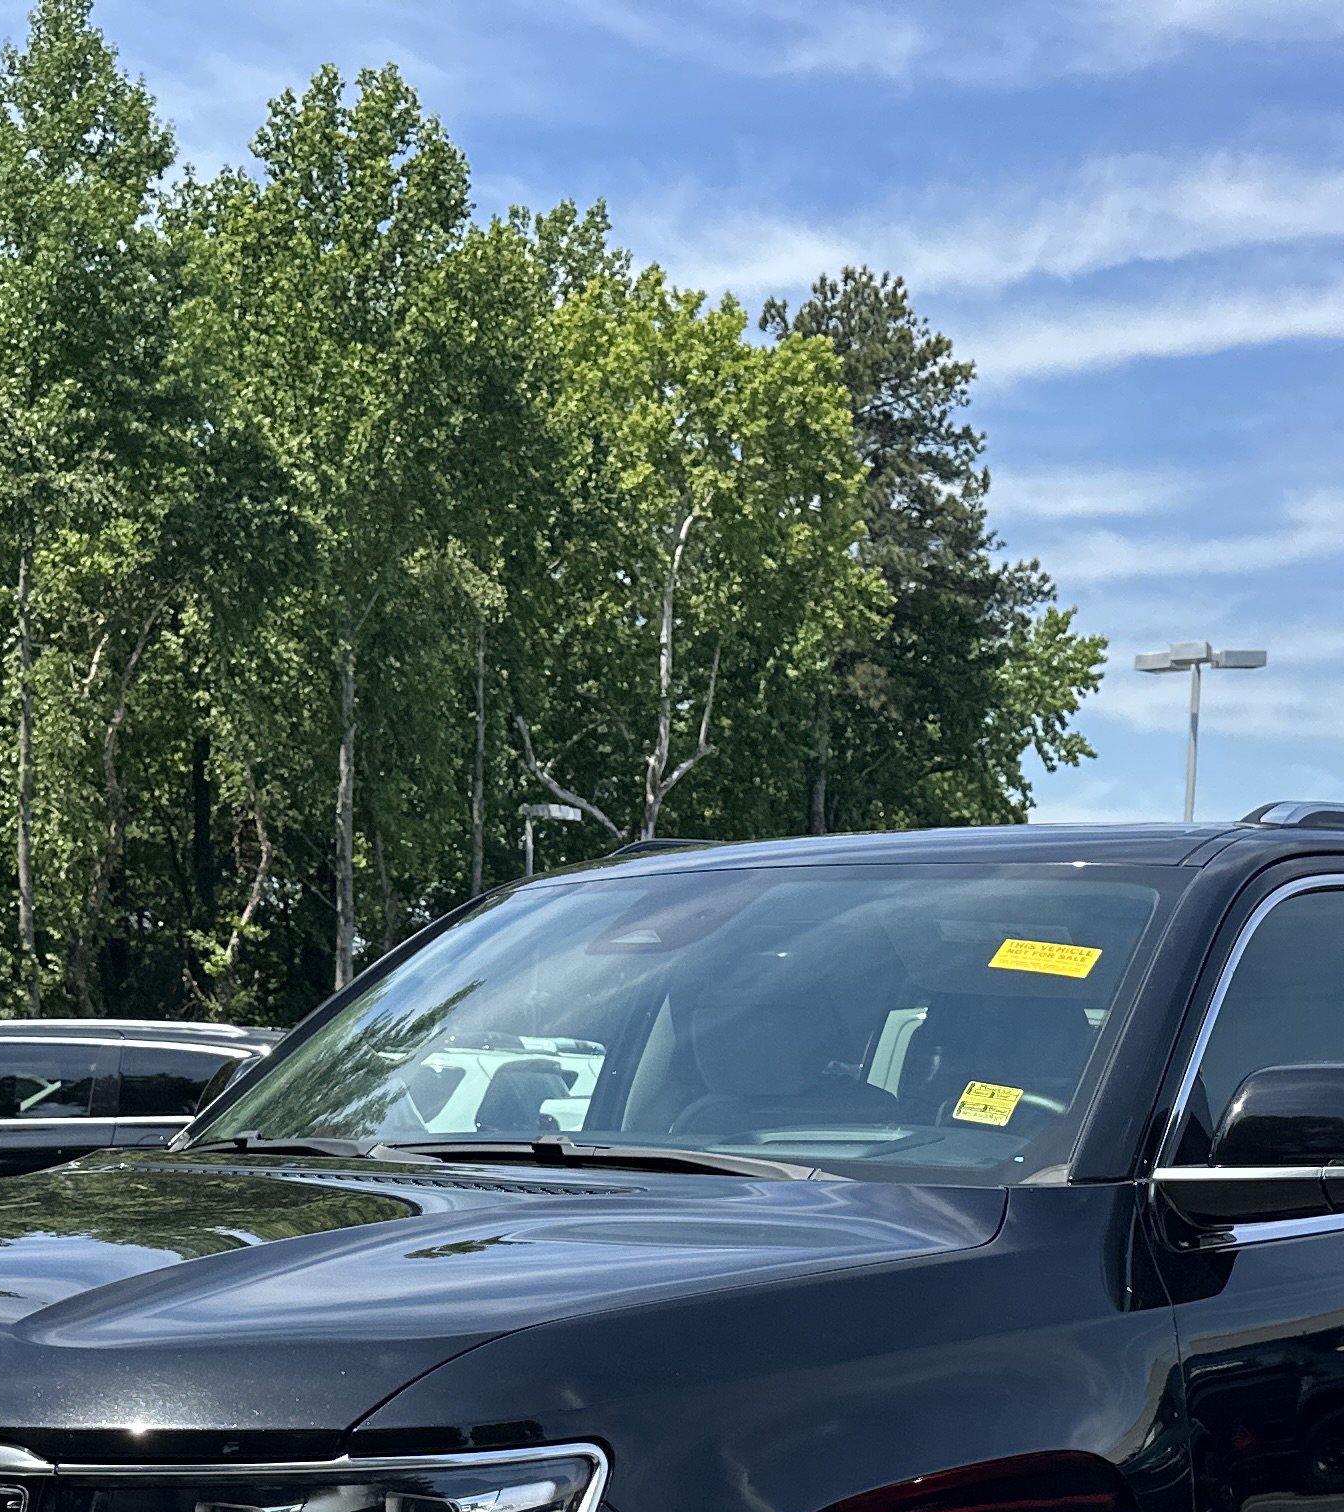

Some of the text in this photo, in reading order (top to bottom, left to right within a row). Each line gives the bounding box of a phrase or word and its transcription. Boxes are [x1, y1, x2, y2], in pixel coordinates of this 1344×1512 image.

[1008, 941, 1093, 956] THIS VEHICLE
[1057, 955, 1088, 963] SALE
